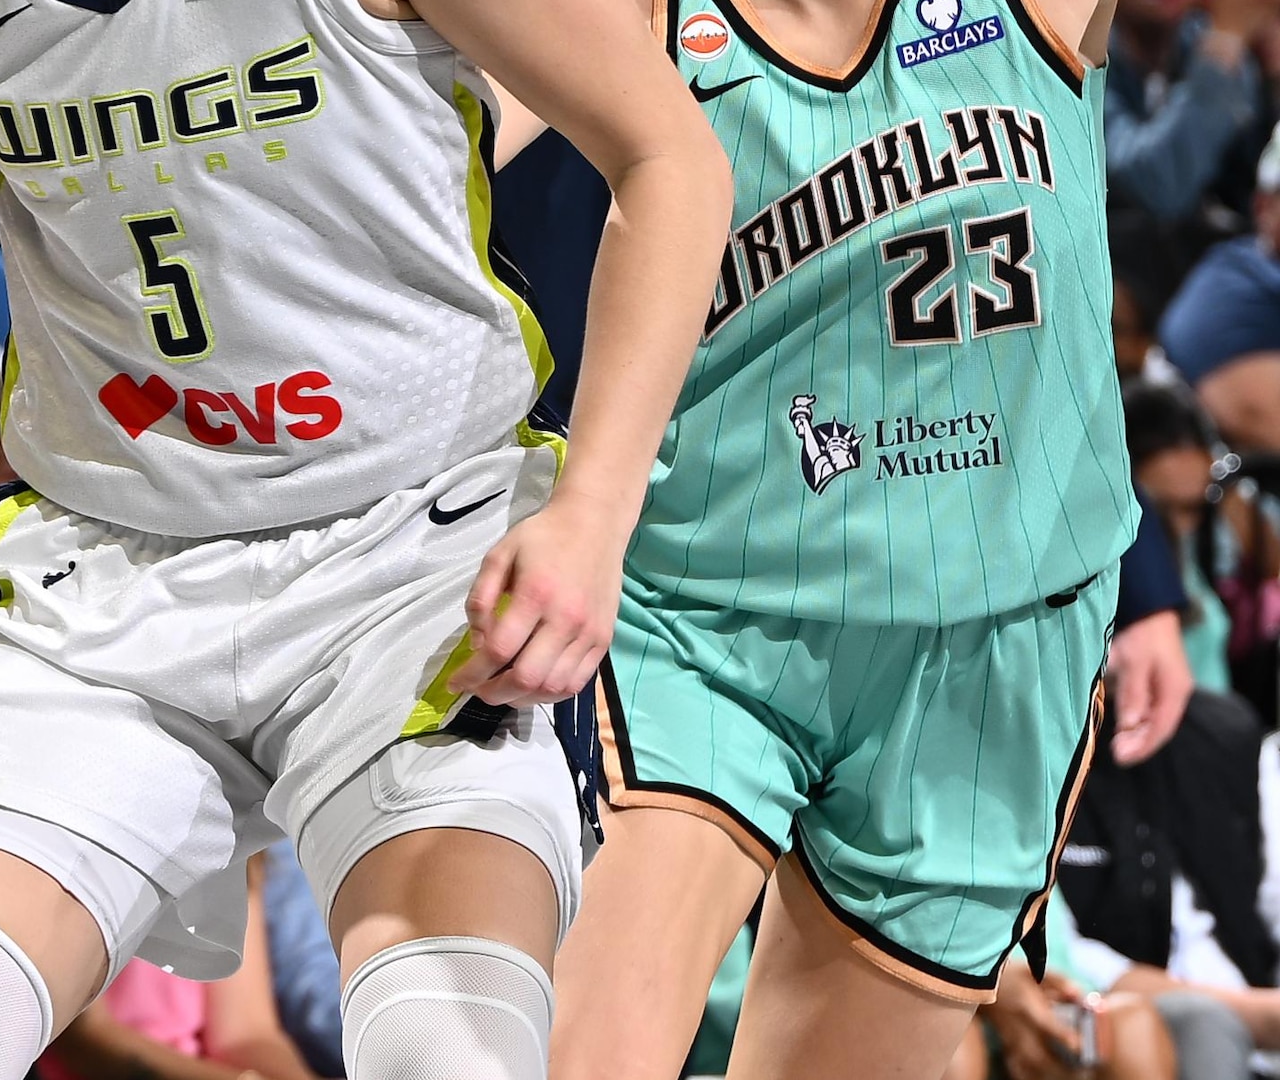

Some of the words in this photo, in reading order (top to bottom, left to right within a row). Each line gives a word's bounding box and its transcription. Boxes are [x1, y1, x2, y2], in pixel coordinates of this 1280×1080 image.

[901, 19, 999, 65] BARCLAYS
[24, 138, 289, 200] DALLAS
[121, 208, 215, 363] 5
[880, 205, 1042, 348] 23
[183, 370, 343, 446] CVS
[873, 410, 997, 449] Liberty
[874, 435, 1003, 481] Mutual
